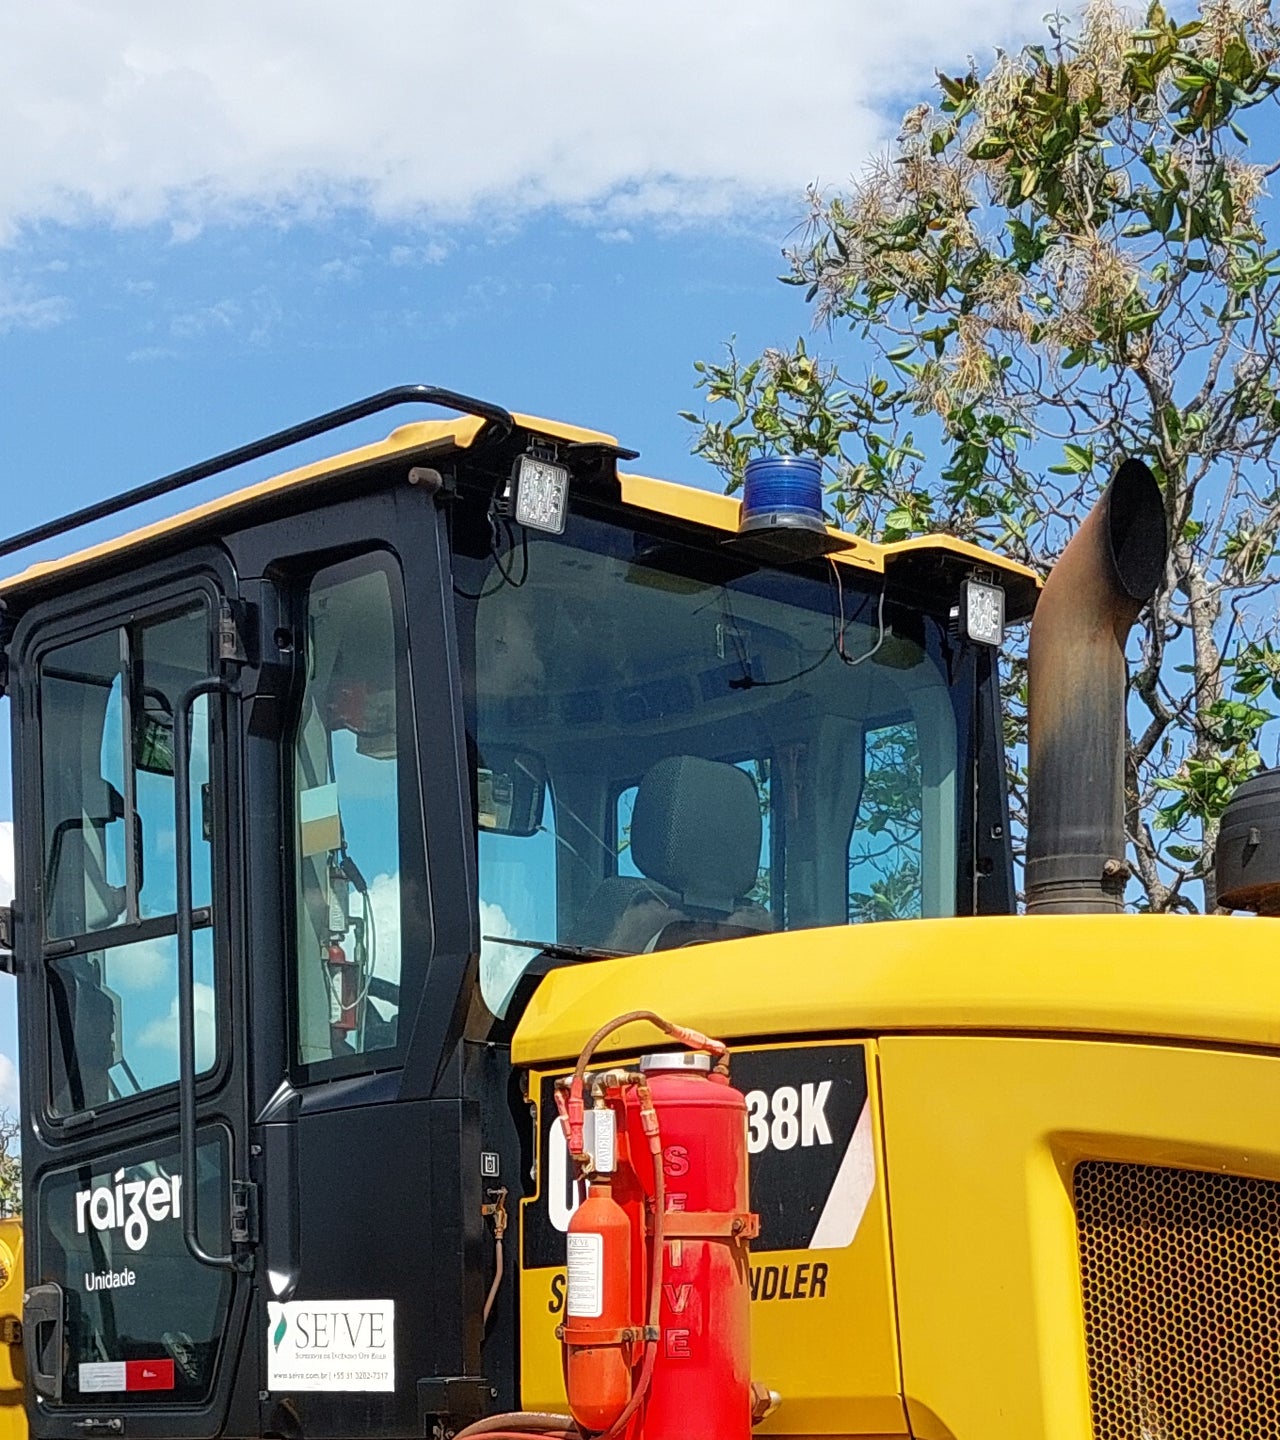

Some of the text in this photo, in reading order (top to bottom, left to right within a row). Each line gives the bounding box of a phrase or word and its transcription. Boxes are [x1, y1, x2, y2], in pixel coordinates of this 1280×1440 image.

[745, 1080, 833, 1153] 38K
[85, 1266, 136, 1291] Unidade
[749, 1262, 828, 1301] NDLER
[295, 1312, 386, 1348] SEIVE
